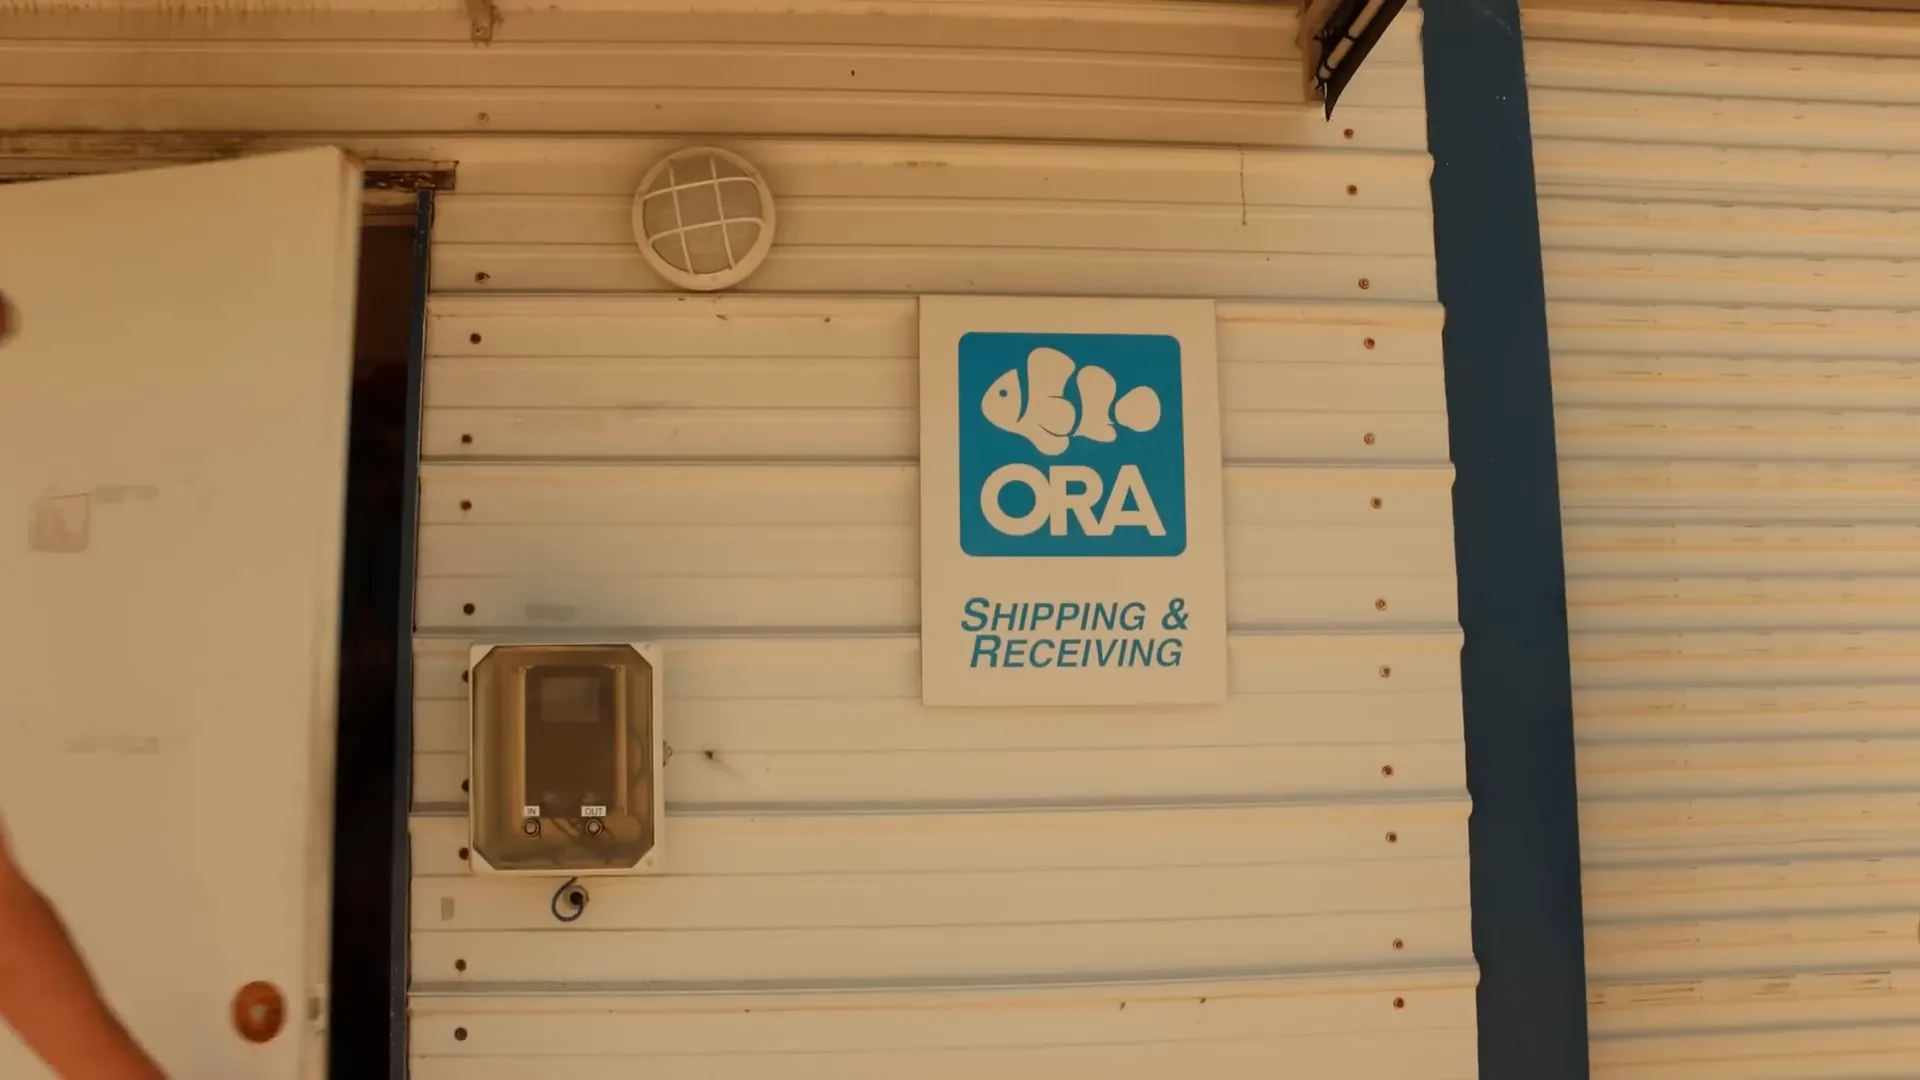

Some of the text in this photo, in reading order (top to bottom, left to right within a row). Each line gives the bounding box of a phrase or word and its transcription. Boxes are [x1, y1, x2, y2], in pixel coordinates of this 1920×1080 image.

[980, 463, 1166, 537] ORA
[960, 597, 1189, 632] SHIPPING &
[970, 634, 1183, 668] RECEIVING
[526, 807, 537, 816] IN
[584, 807, 604, 816] OUT
